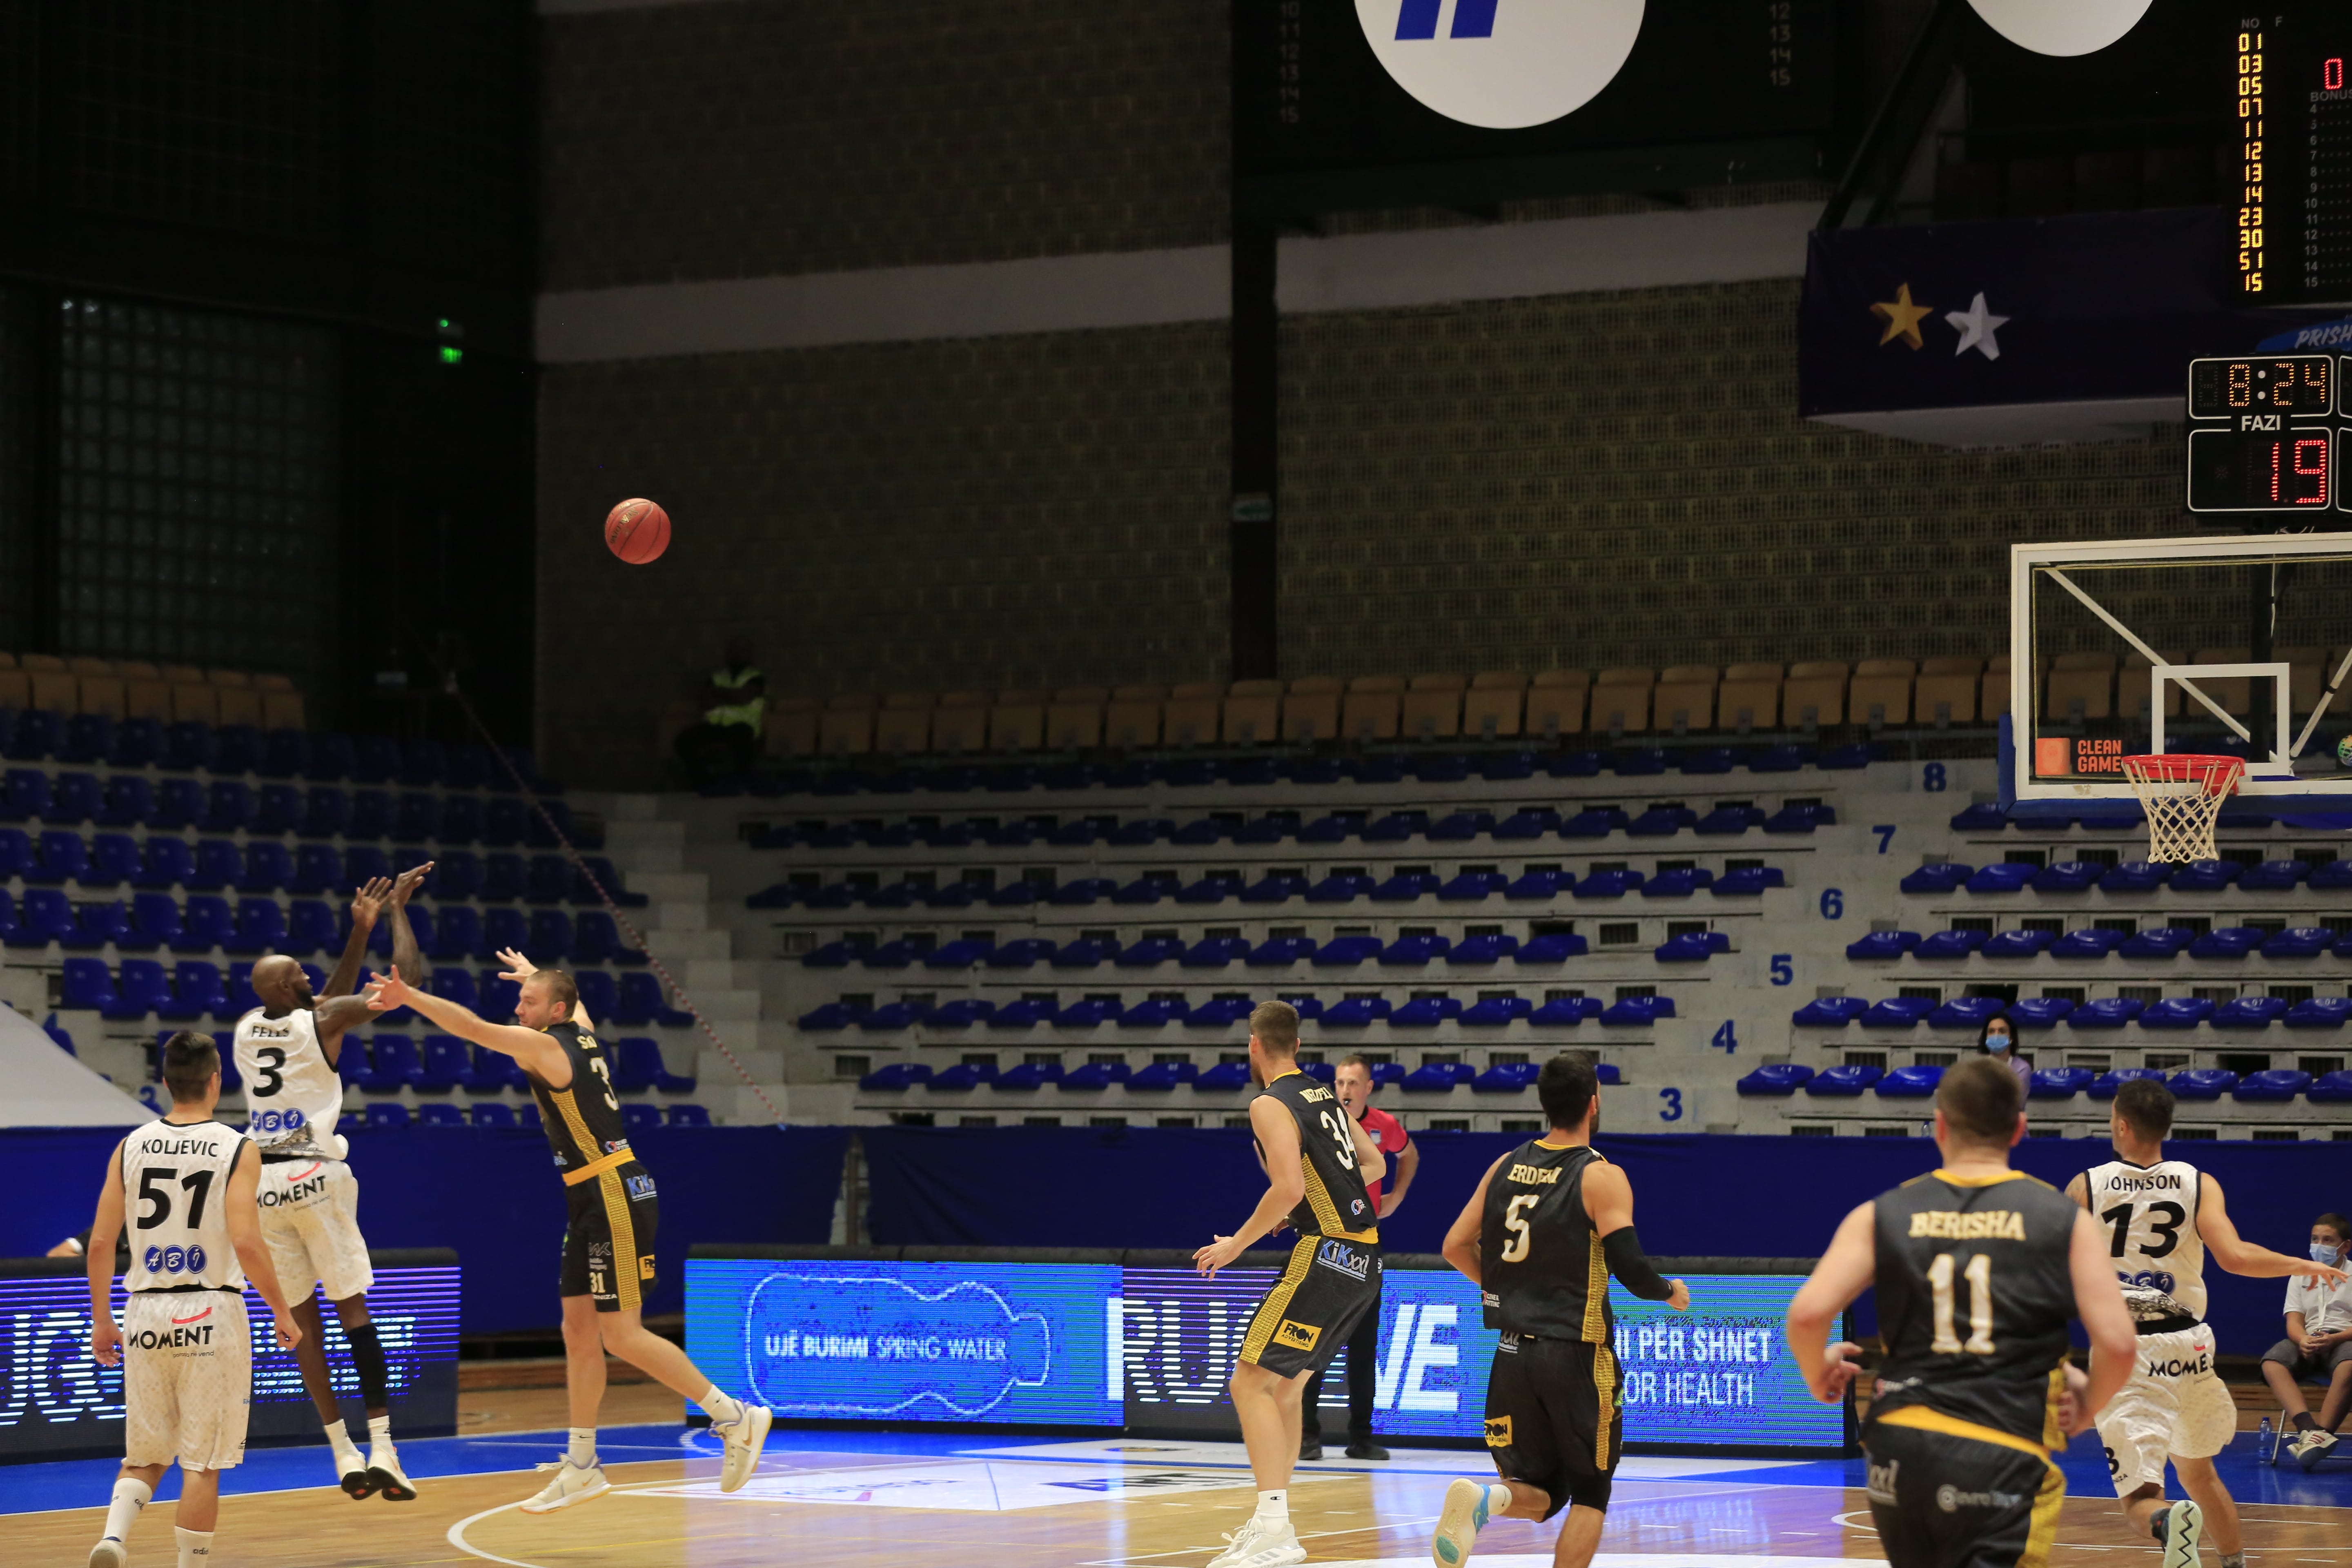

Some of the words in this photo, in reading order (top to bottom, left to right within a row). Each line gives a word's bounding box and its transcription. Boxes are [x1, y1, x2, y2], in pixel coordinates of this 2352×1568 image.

[1768, 2, 1792, 20] 12
[2241, 17, 2260, 29] NO
[2275, 16, 2283, 27] F
[1768, 24, 1792, 42] 13
[2239, 33, 2262, 51] 01
[1768, 46, 1792, 64] 14
[2239, 54, 2262, 74] 03
[1768, 67, 1792, 86] 15
[2325, 58, 2342, 90] 0
[2239, 76, 2262, 96] 05
[2239, 98, 2262, 117] 07
[2245, 120, 2262, 138] 11
[2310, 135, 2317, 146] 6
[2245, 141, 2262, 160] 12
[2310, 150, 2317, 161] 7
[2245, 163, 2262, 182] 13
[2310, 166, 2317, 177] 8
[2245, 185, 2262, 203] 14
[2310, 182, 2317, 193] 9
[2304, 198, 2317, 209] 10
[2239, 207, 2262, 226] 23
[2306, 214, 2317, 225] 11
[2240, 228, 2262, 248] 30
[2304, 229, 2317, 241] 12
[2304, 245, 2317, 256] 13
[2240, 252, 2262, 270] 51
[2304, 261, 2317, 272] 14
[2245, 273, 2262, 292] 15
[2304, 276, 2317, 287] 15
[2230, 363, 2325, 407] 8:24
[2241, 415, 2280, 431] FAZI
[2272, 439, 2326, 503] 19
[2078, 740, 2121, 755] CLEAN
[2078, 756, 2121, 773] GAME
[1924, 762, 1947, 792] 8
[1872, 825, 1896, 853] 7
[1820, 888, 1843, 920] 6
[1770, 954, 1793, 986] 5
[252, 1026, 289, 1037] FELLS
[1711, 1020, 1737, 1054] 4
[253, 1047, 285, 1097] 3
[1659, 1087, 1683, 1121] 3
[142, 1139, 219, 1157] KOLJEVIC
[1320, 1107, 1358, 1170] 34
[2104, 1175, 2180, 1192] JOHNSON
[137, 1167, 215, 1229] 51
[1501, 1194, 1540, 1263] 5
[1908, 1210, 2026, 1241] BERISHA
[2101, 1201, 2185, 1258] 13
[589, 1272, 606, 1294] 31
[1926, 1253, 1996, 1355] 11
[1281, 1334, 1309, 1348] ADVERTISING
[1284, 1323, 1314, 1343] FRON
[803, 1334, 869, 1358] BURIMI
[875, 1336, 942, 1360] SPRING
[1693, 1328, 1771, 1361] SHNET
[2148, 1353, 2213, 1377] MOME
[1664, 1372, 1753, 1405] HEALTH
